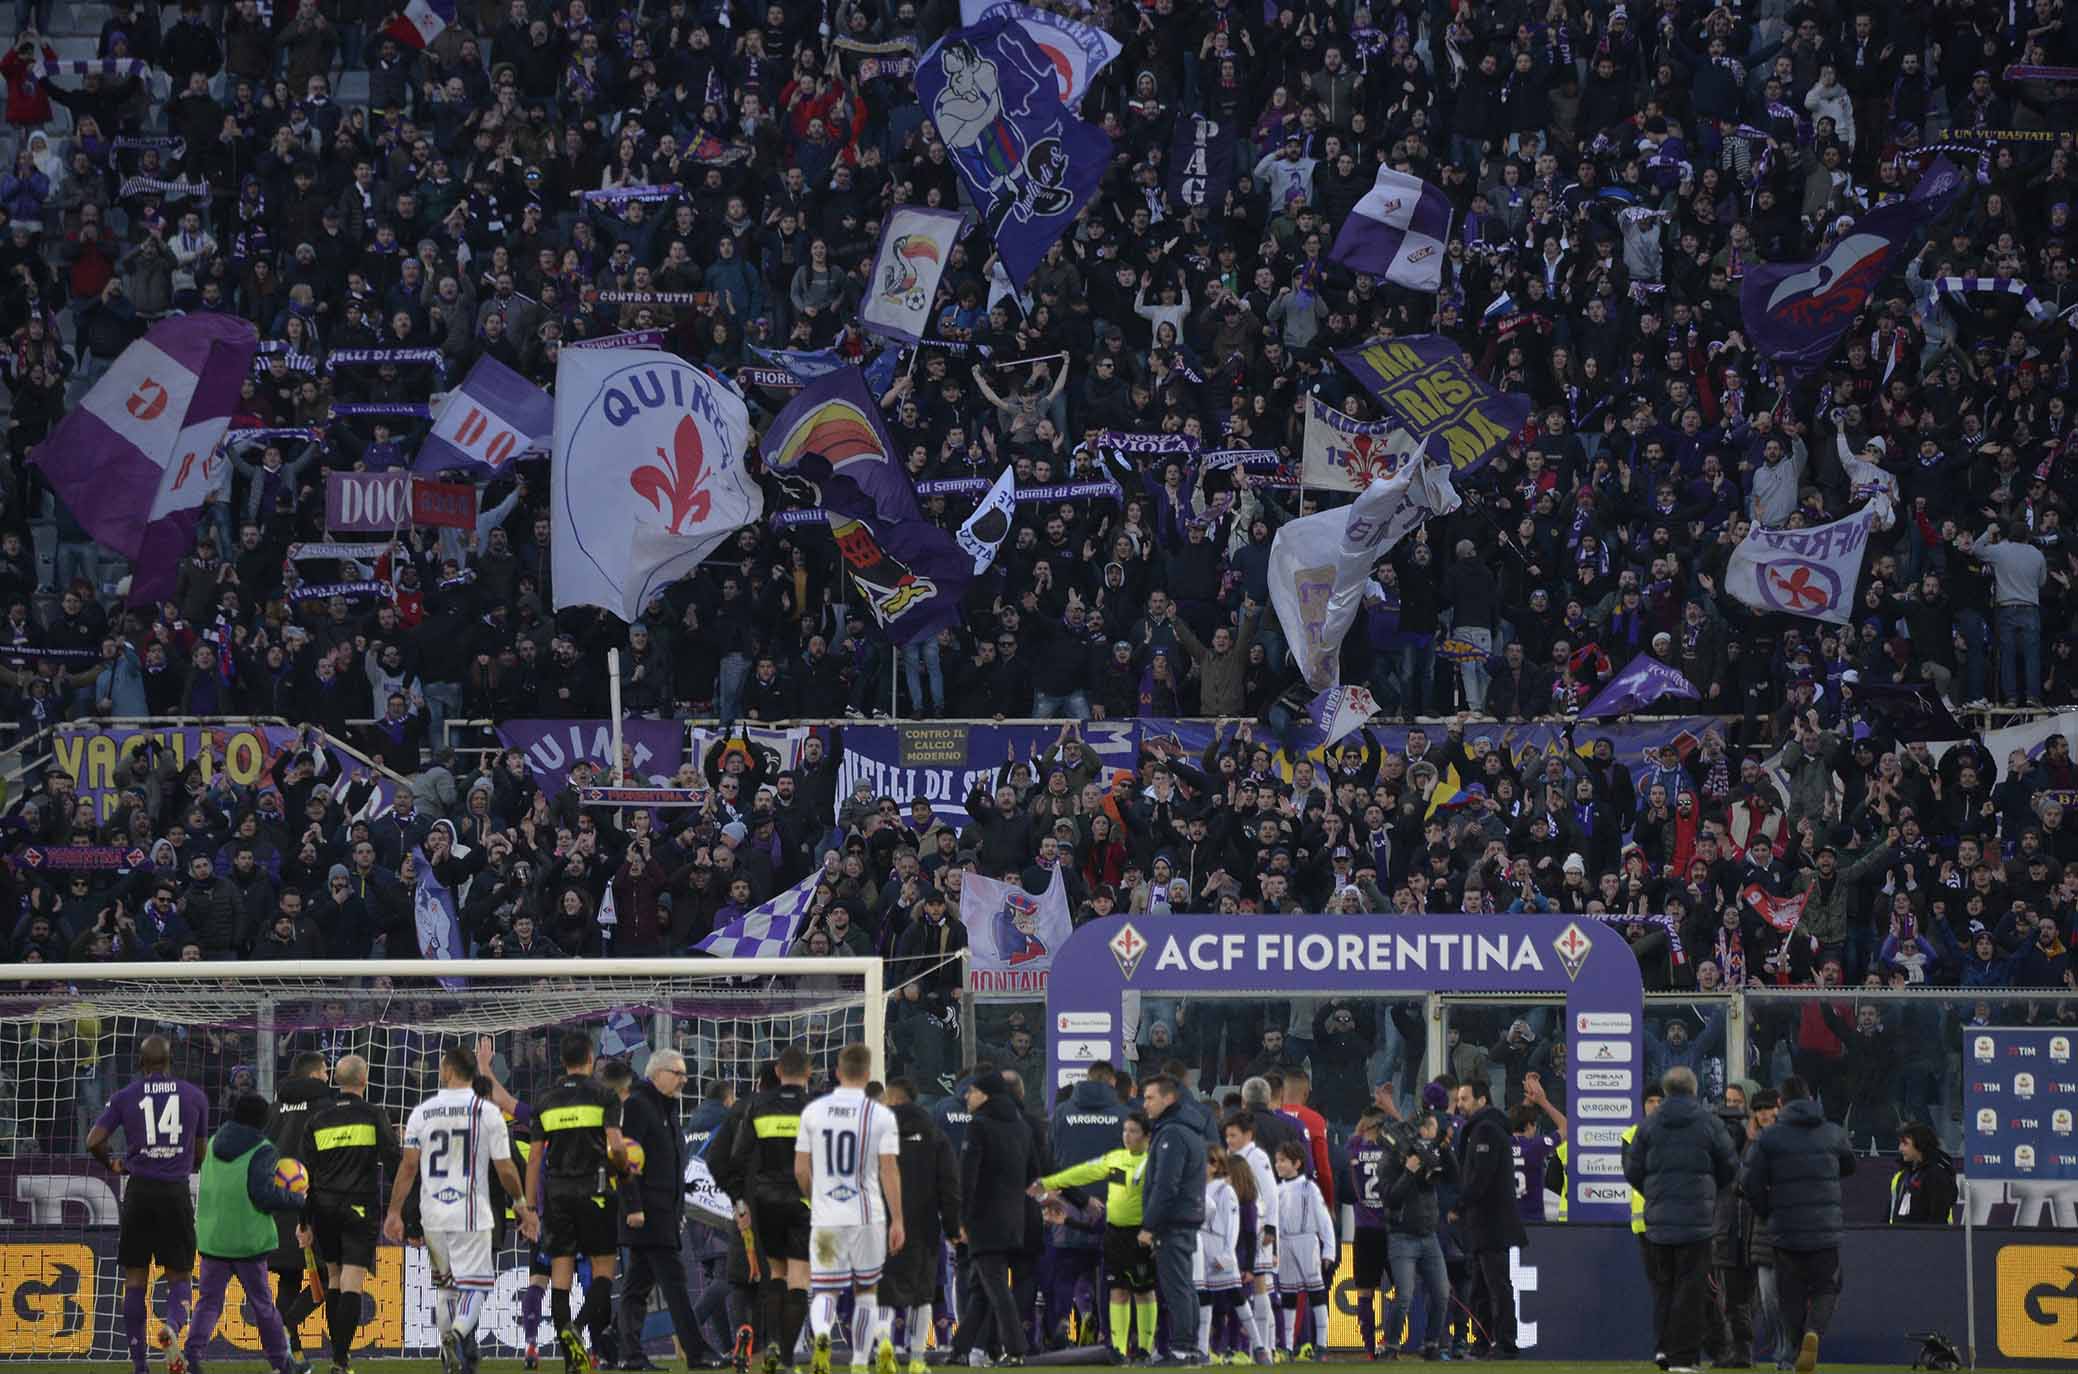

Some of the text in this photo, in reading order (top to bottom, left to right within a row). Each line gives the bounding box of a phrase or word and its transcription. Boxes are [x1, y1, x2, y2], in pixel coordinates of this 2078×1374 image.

[599, 291, 693, 303] CONTRO TUTTI
[1111, 440, 1190, 452] VIOLA
[905, 730, 950, 738] CONTRO
[914, 741, 954, 750] CALCIO
[907, 752, 961, 760] MODERNO
[925, 769, 953, 803] DI
[1155, 934, 1544, 971] ACF FIORENTINA
[2019, 1047, 2036, 1057] TIM
[1983, 1083, 2000, 1092] TIM
[2059, 1083, 2076, 1093] TIM
[138, 1094, 183, 1145] 14
[1066, 1114, 1119, 1126] VARGROUP
[2021, 1119, 2038, 1129] TIM
[429, 1128, 471, 1178] 27
[823, 1129, 856, 1177] 10
[1983, 1155, 2000, 1165] TIM
[2059, 1155, 2076, 1165] TIM
[1363, 1162, 1380, 1199] 2
[1592, 1190, 1626, 1199] NGM
